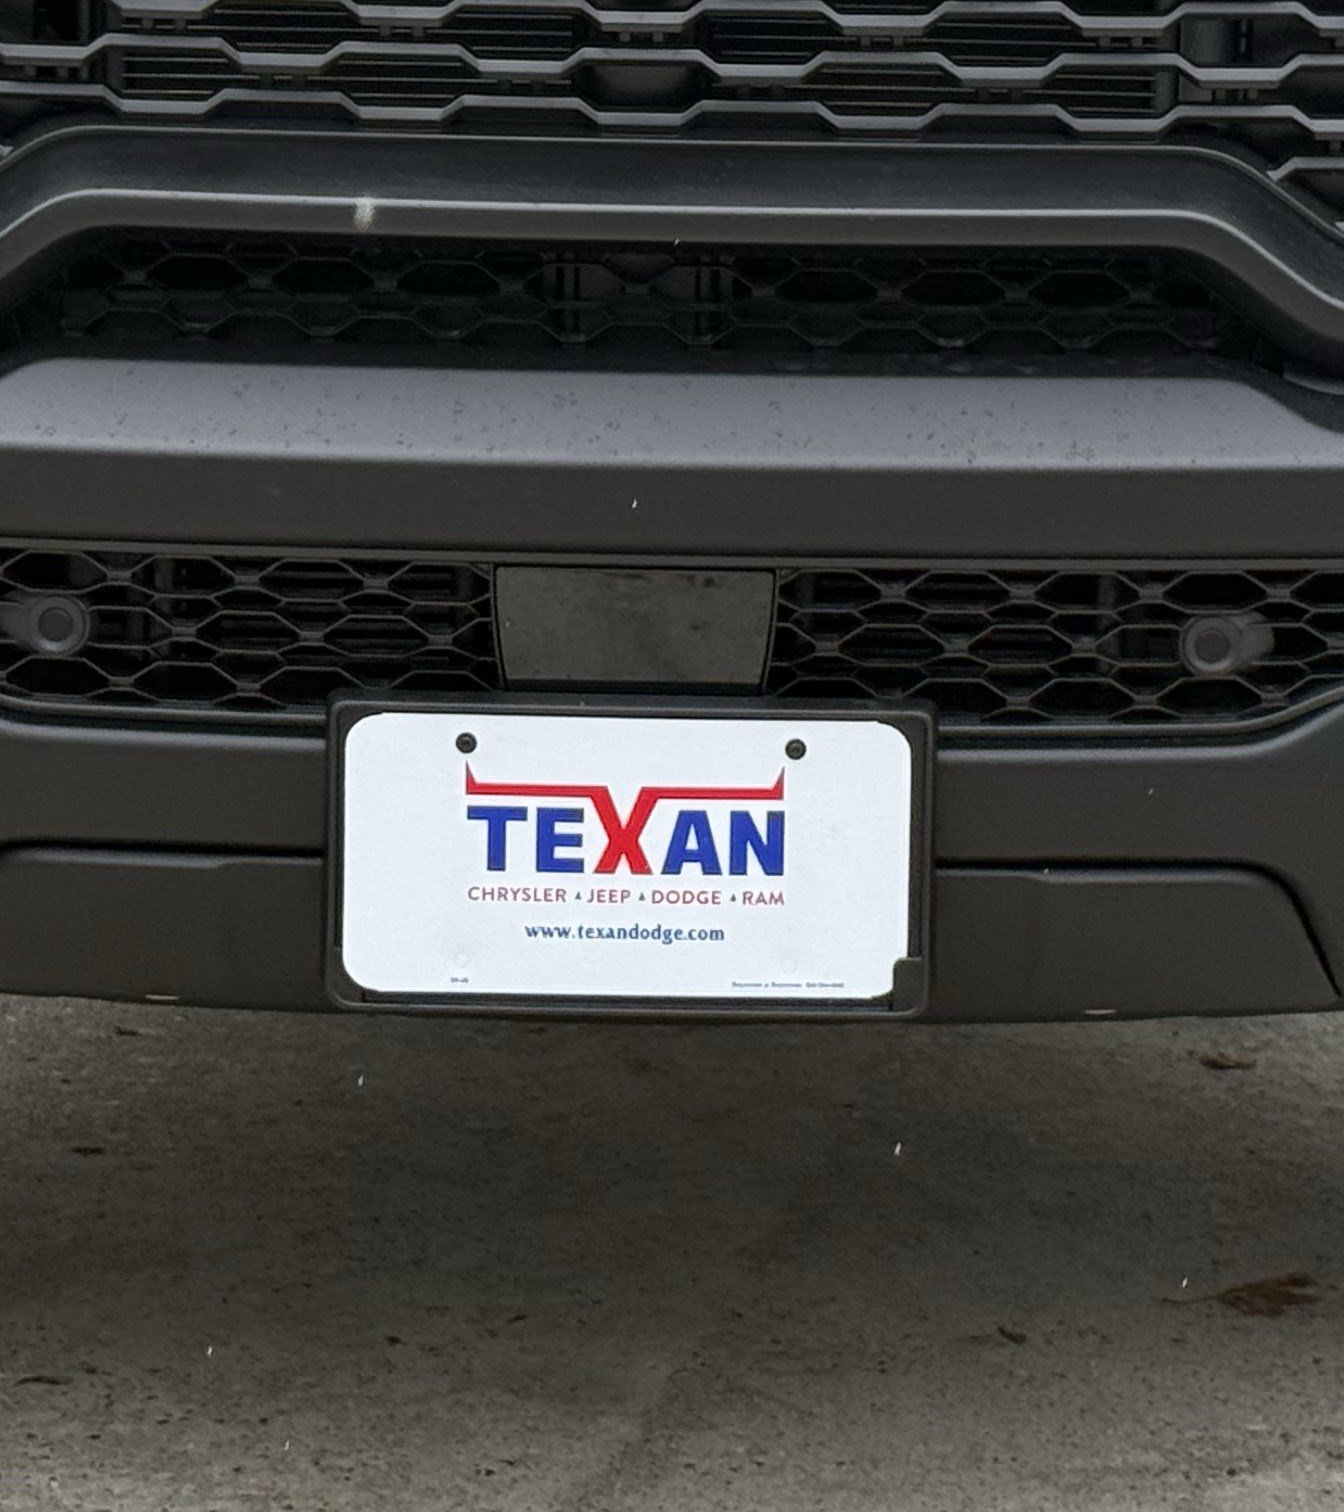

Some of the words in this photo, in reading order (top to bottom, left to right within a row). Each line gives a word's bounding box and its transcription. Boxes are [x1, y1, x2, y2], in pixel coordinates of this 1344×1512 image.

[465, 762, 786, 877] TEXAN
[467, 885, 568, 905] CHRYSLER
[586, 887, 632, 906] JEEP
[650, 888, 723, 907] DODGE
[741, 890, 786, 908] RAM
[523, 921, 726, 945] www.texandodge.com
